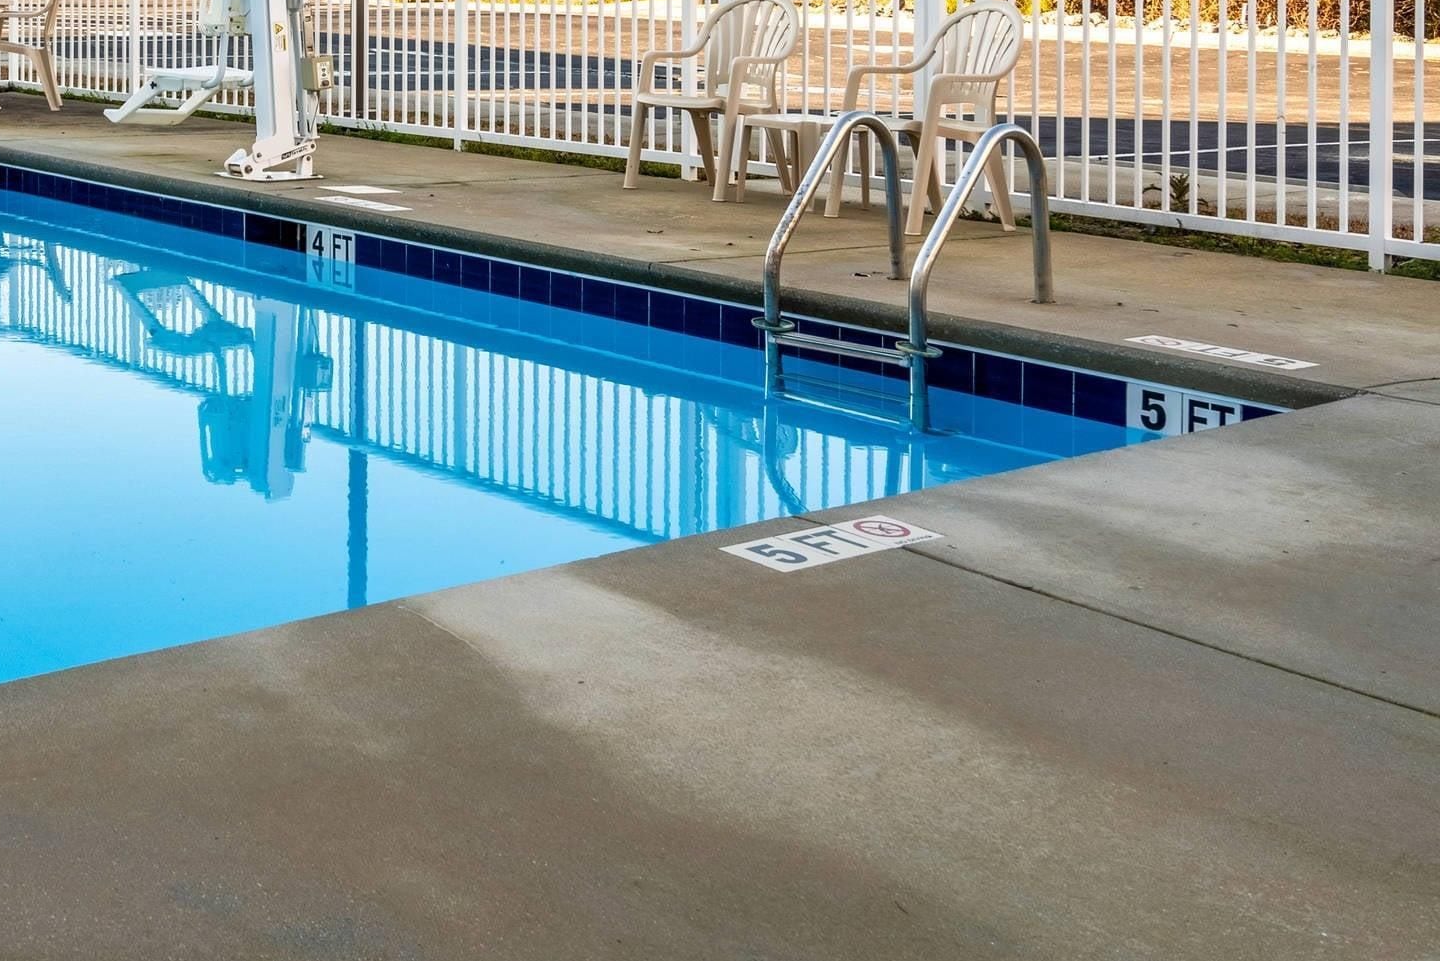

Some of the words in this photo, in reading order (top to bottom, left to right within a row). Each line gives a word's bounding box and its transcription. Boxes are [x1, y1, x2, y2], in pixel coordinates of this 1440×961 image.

[312, 230, 325, 257] 4
[332, 233, 353, 262] FT
[1140, 390, 1166, 430] 5
[1187, 398, 1235, 433] FT
[746, 543, 808, 564] 5
[789, 529, 869, 555] FT
